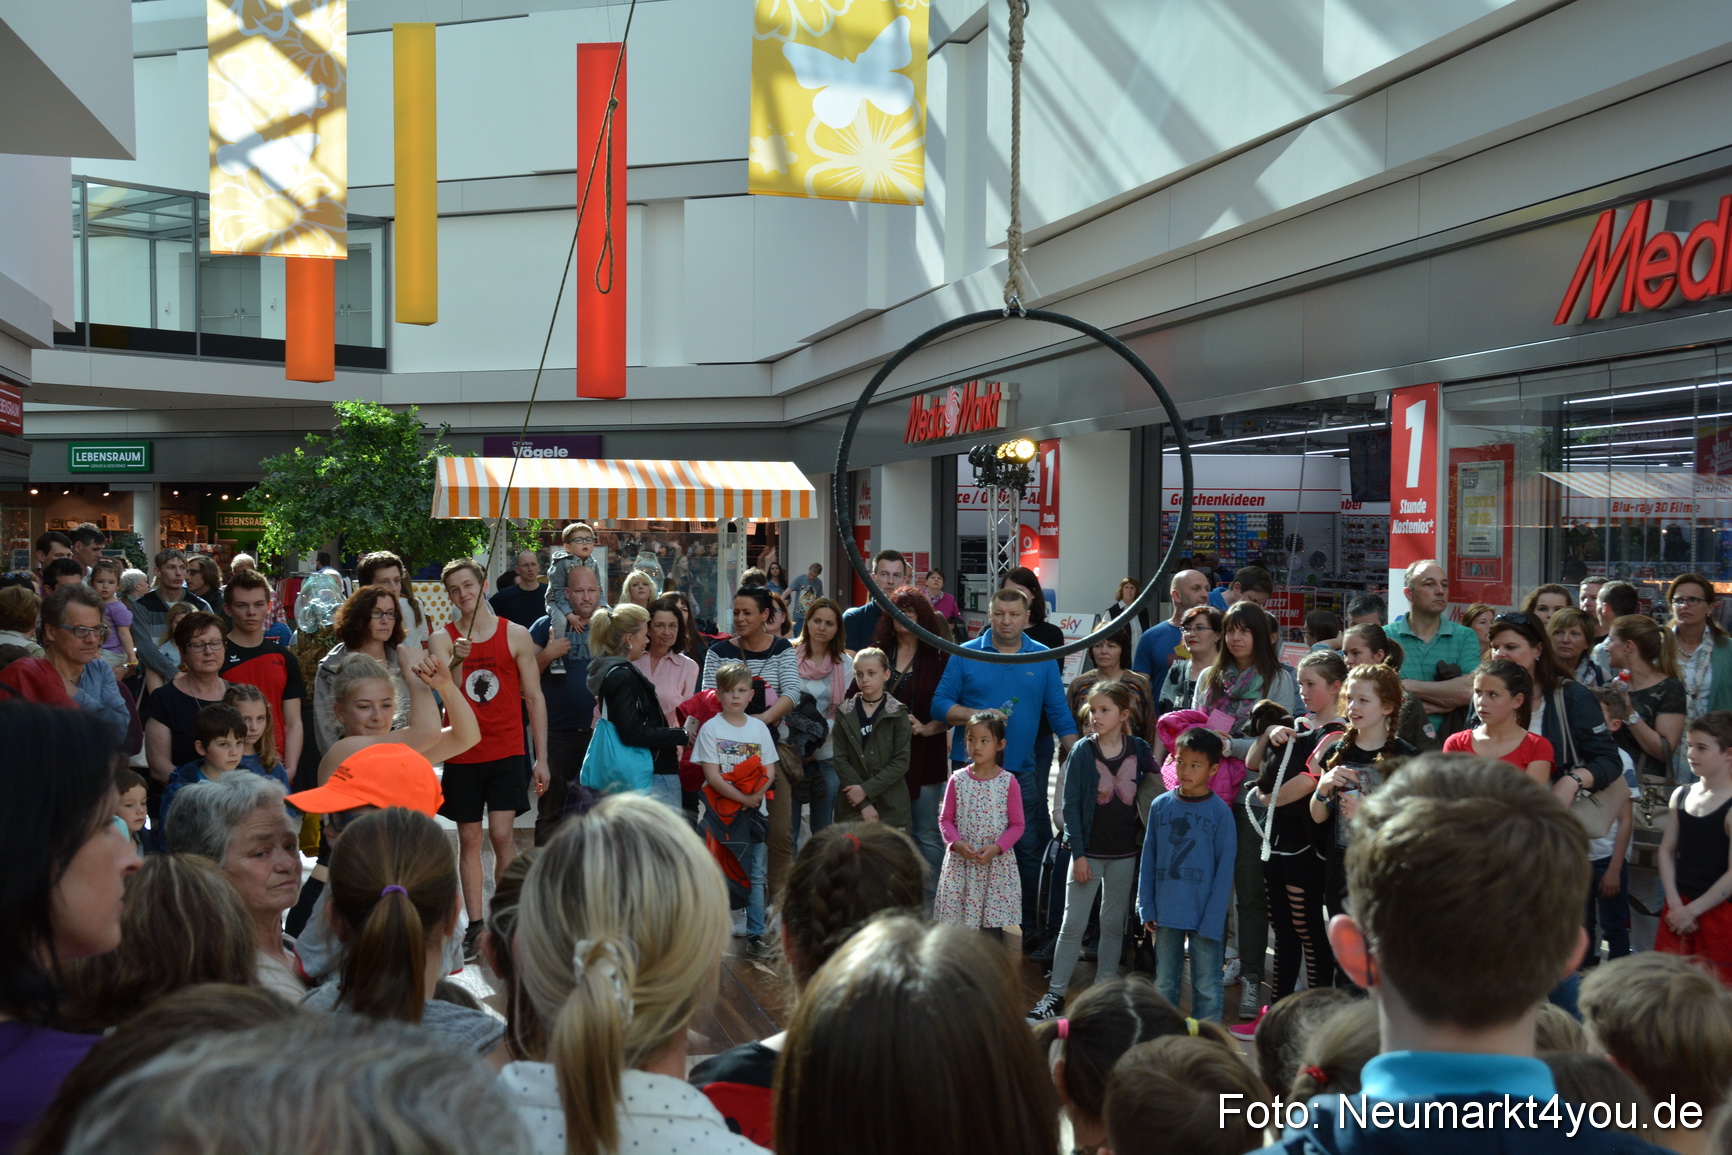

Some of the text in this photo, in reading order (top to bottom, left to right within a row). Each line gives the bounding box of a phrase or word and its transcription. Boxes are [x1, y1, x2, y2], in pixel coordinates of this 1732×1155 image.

[1405, 400, 1426, 488] 1
[76, 452, 141, 462] LEBENSRAUM
[512, 446, 569, 459] Vögele
[1045, 449, 1055, 506] 1
[1170, 493, 1265, 506] Gchenkideen
[1400, 497, 1427, 514] Stunde
[1612, 501, 1653, 515] Blu-ray
[1655, 502, 1668, 513] 3D
[1270, 609, 1300, 618] ESTEN!
[1060, 615, 1082, 633] sky
